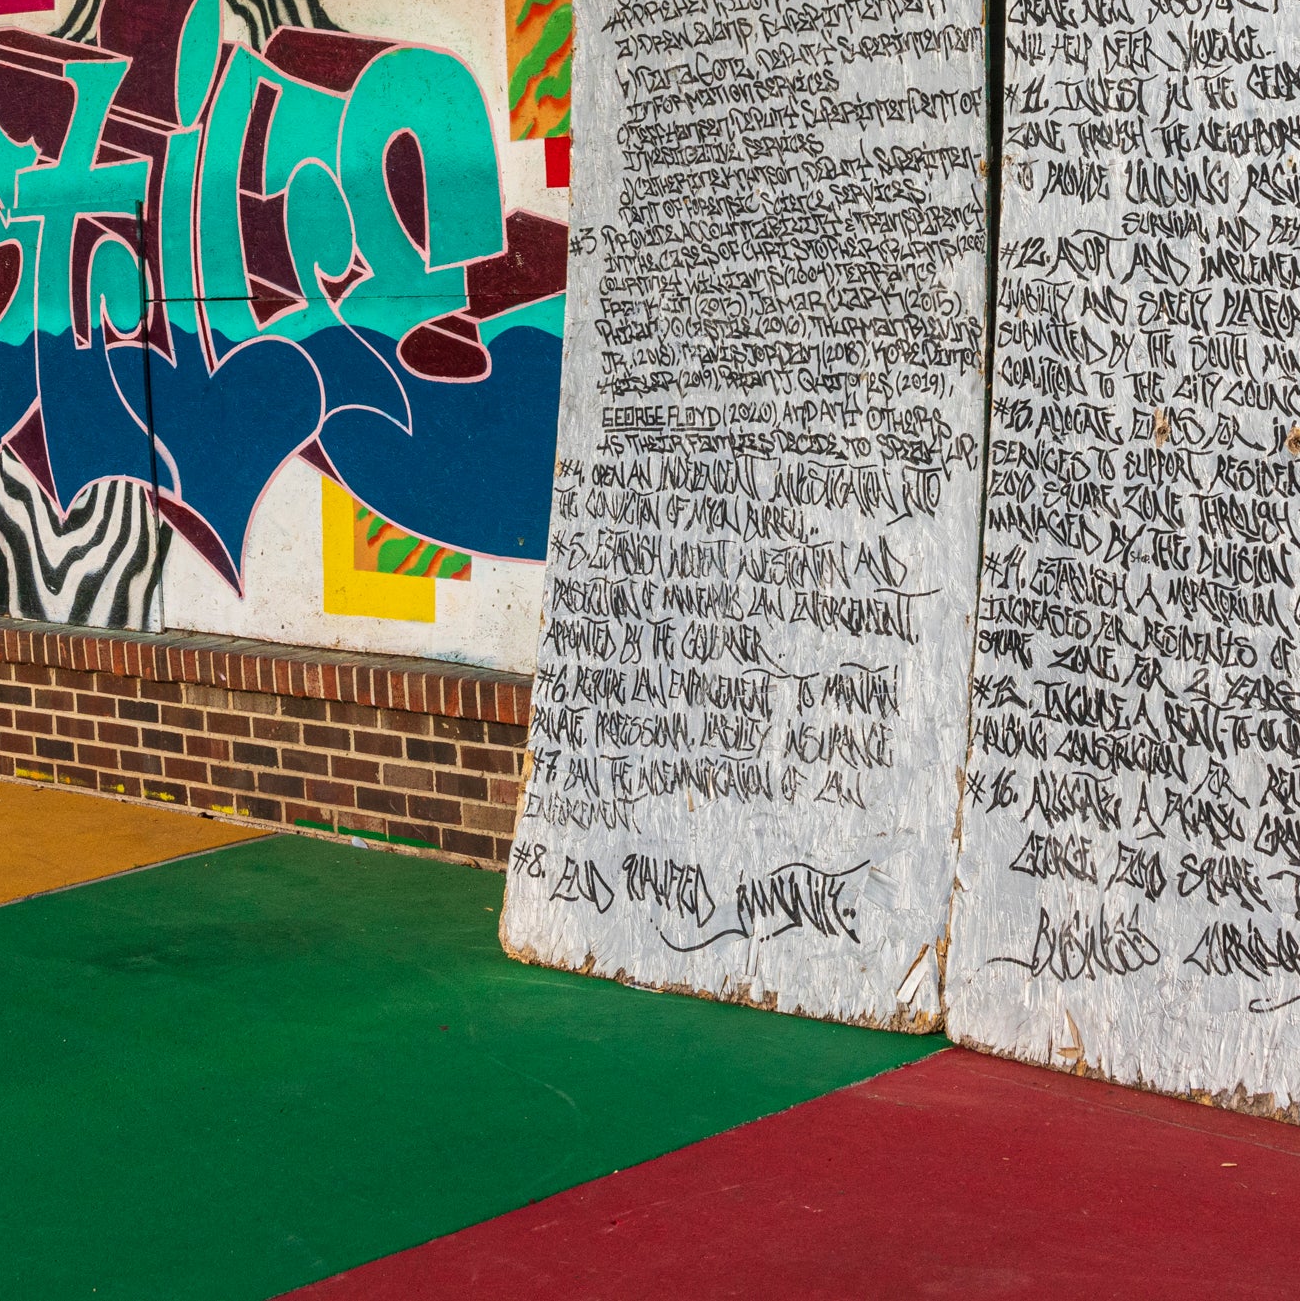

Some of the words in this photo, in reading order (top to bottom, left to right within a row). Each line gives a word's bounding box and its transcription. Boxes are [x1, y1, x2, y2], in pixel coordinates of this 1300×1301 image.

[1122, 241, 1189, 287] AND
[602, 406, 664, 427] GEORGE
[669, 404, 720, 427] FLOYD
[550, 856, 614, 914] END
